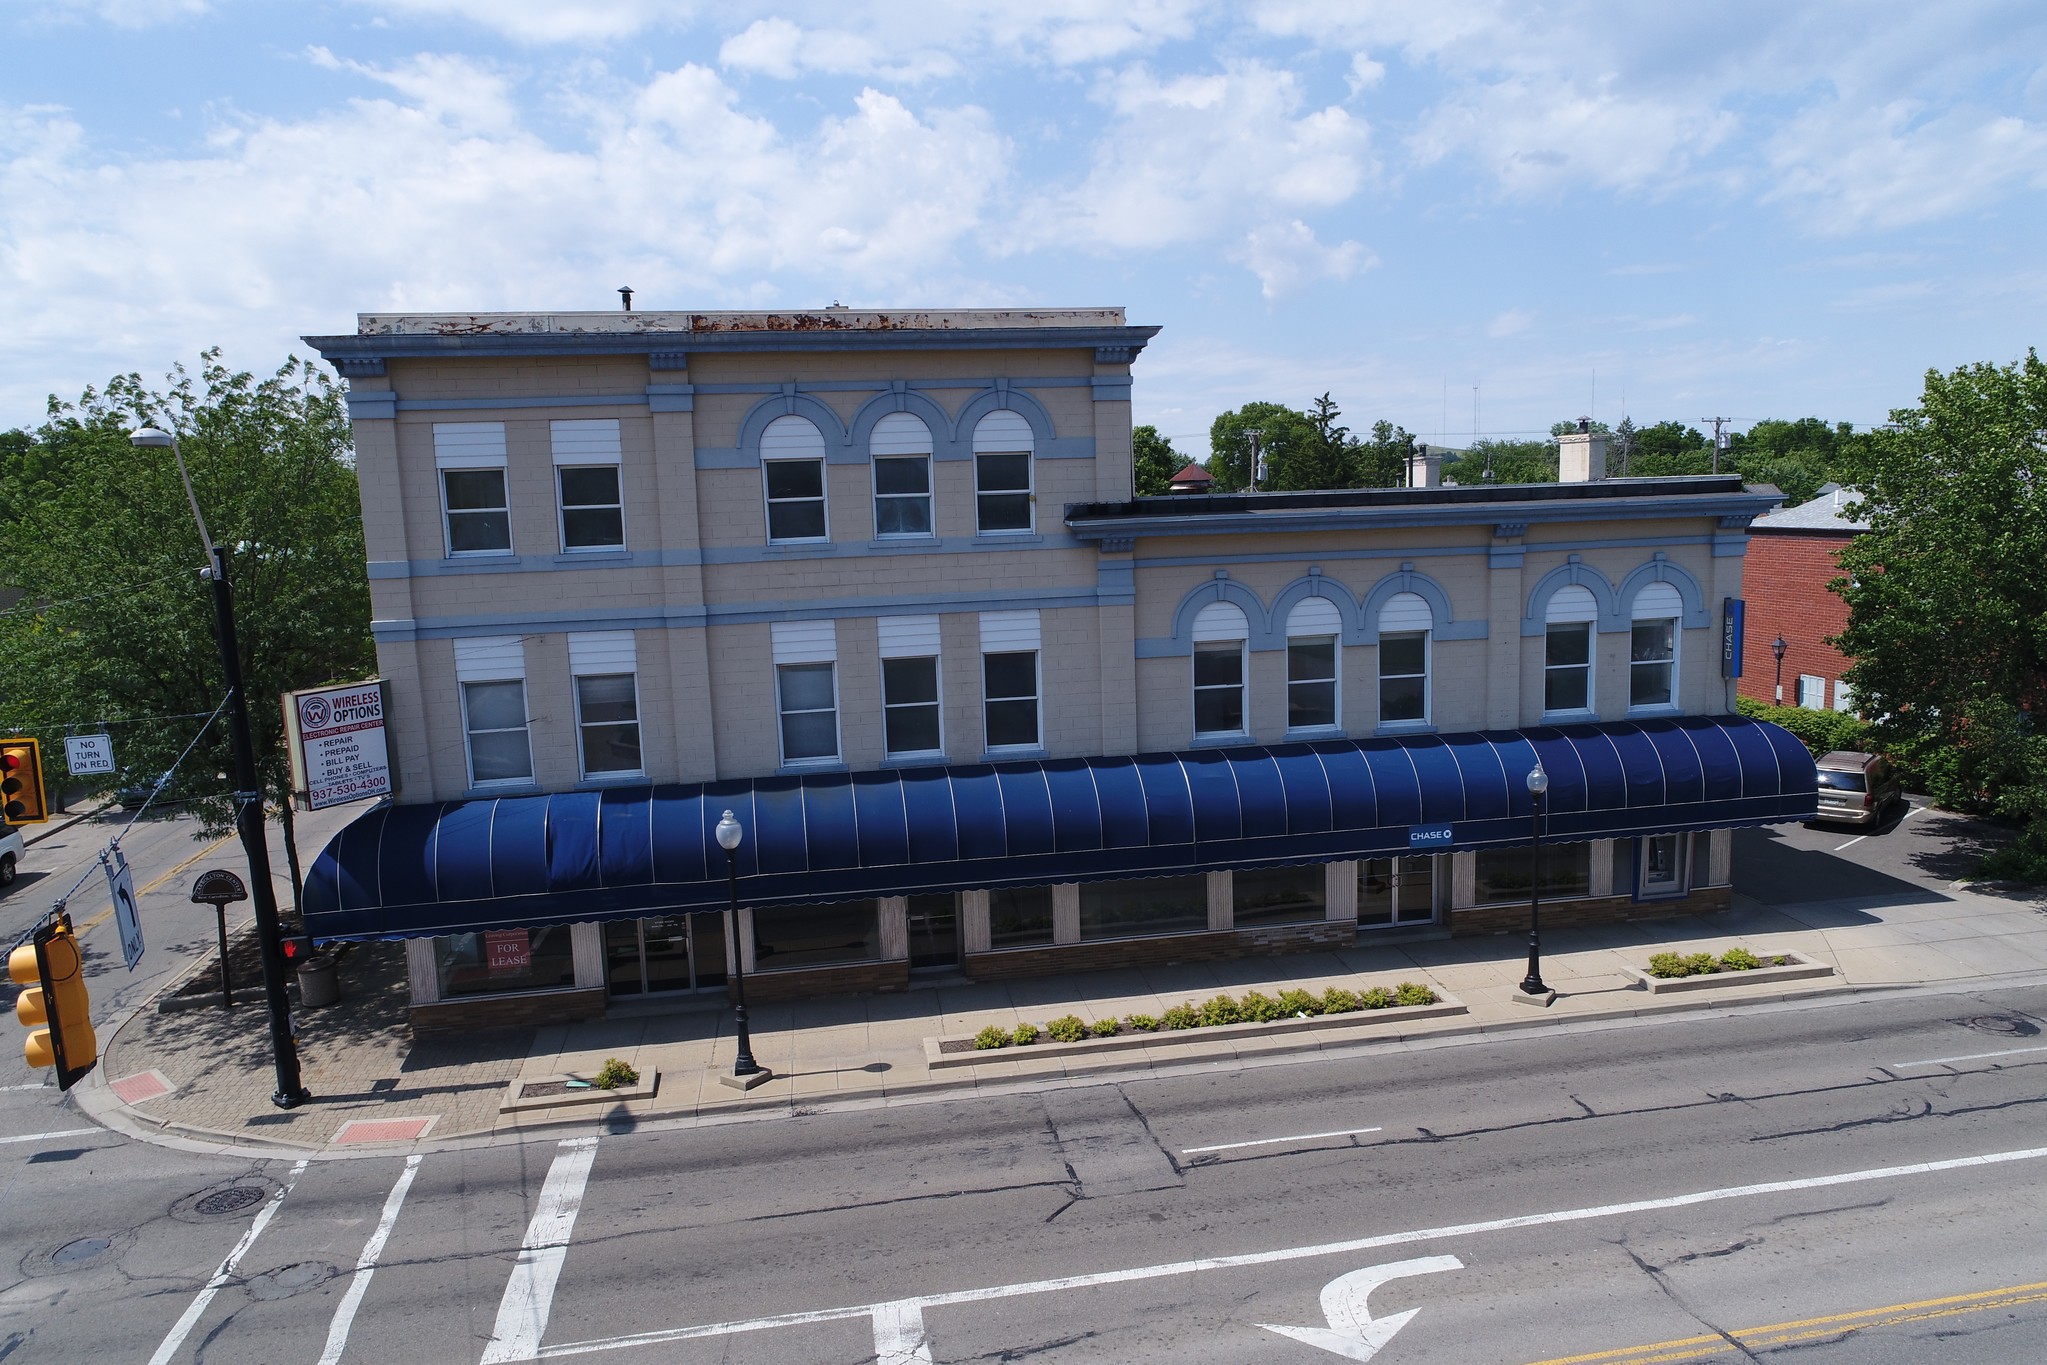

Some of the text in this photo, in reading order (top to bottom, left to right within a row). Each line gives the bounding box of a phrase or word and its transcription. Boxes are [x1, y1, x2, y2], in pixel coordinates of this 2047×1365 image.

[1725, 617, 1733, 660] CHASE
[332, 691, 379, 709] WIRELESS
[334, 704, 380, 723] OPTIONS
[303, 720, 384, 740] ELECTRONIC REPAIR CENTER
[80, 741, 95, 749] NO
[324, 736, 353, 748] REPAIR
[75, 751, 100, 760] TURN
[325, 744, 360, 757] PREPAID
[74, 760, 109, 770] ON RED
[326, 754, 360, 767] BILL PAY
[325, 773, 349, 782] PHONES
[352, 765, 387, 777] COMPUTERS
[327, 767, 344, 777] BUY
[352, 761, 373, 771] SELL
[312, 776, 386, 801] 937-530-4300
[328, 778, 353, 787] TABLETS
[1410, 830, 1442, 841] CHASE
[128, 931, 142, 960] ONLY
[497, 943, 519, 953] FOR
[491, 955, 527, 966] LEASE
